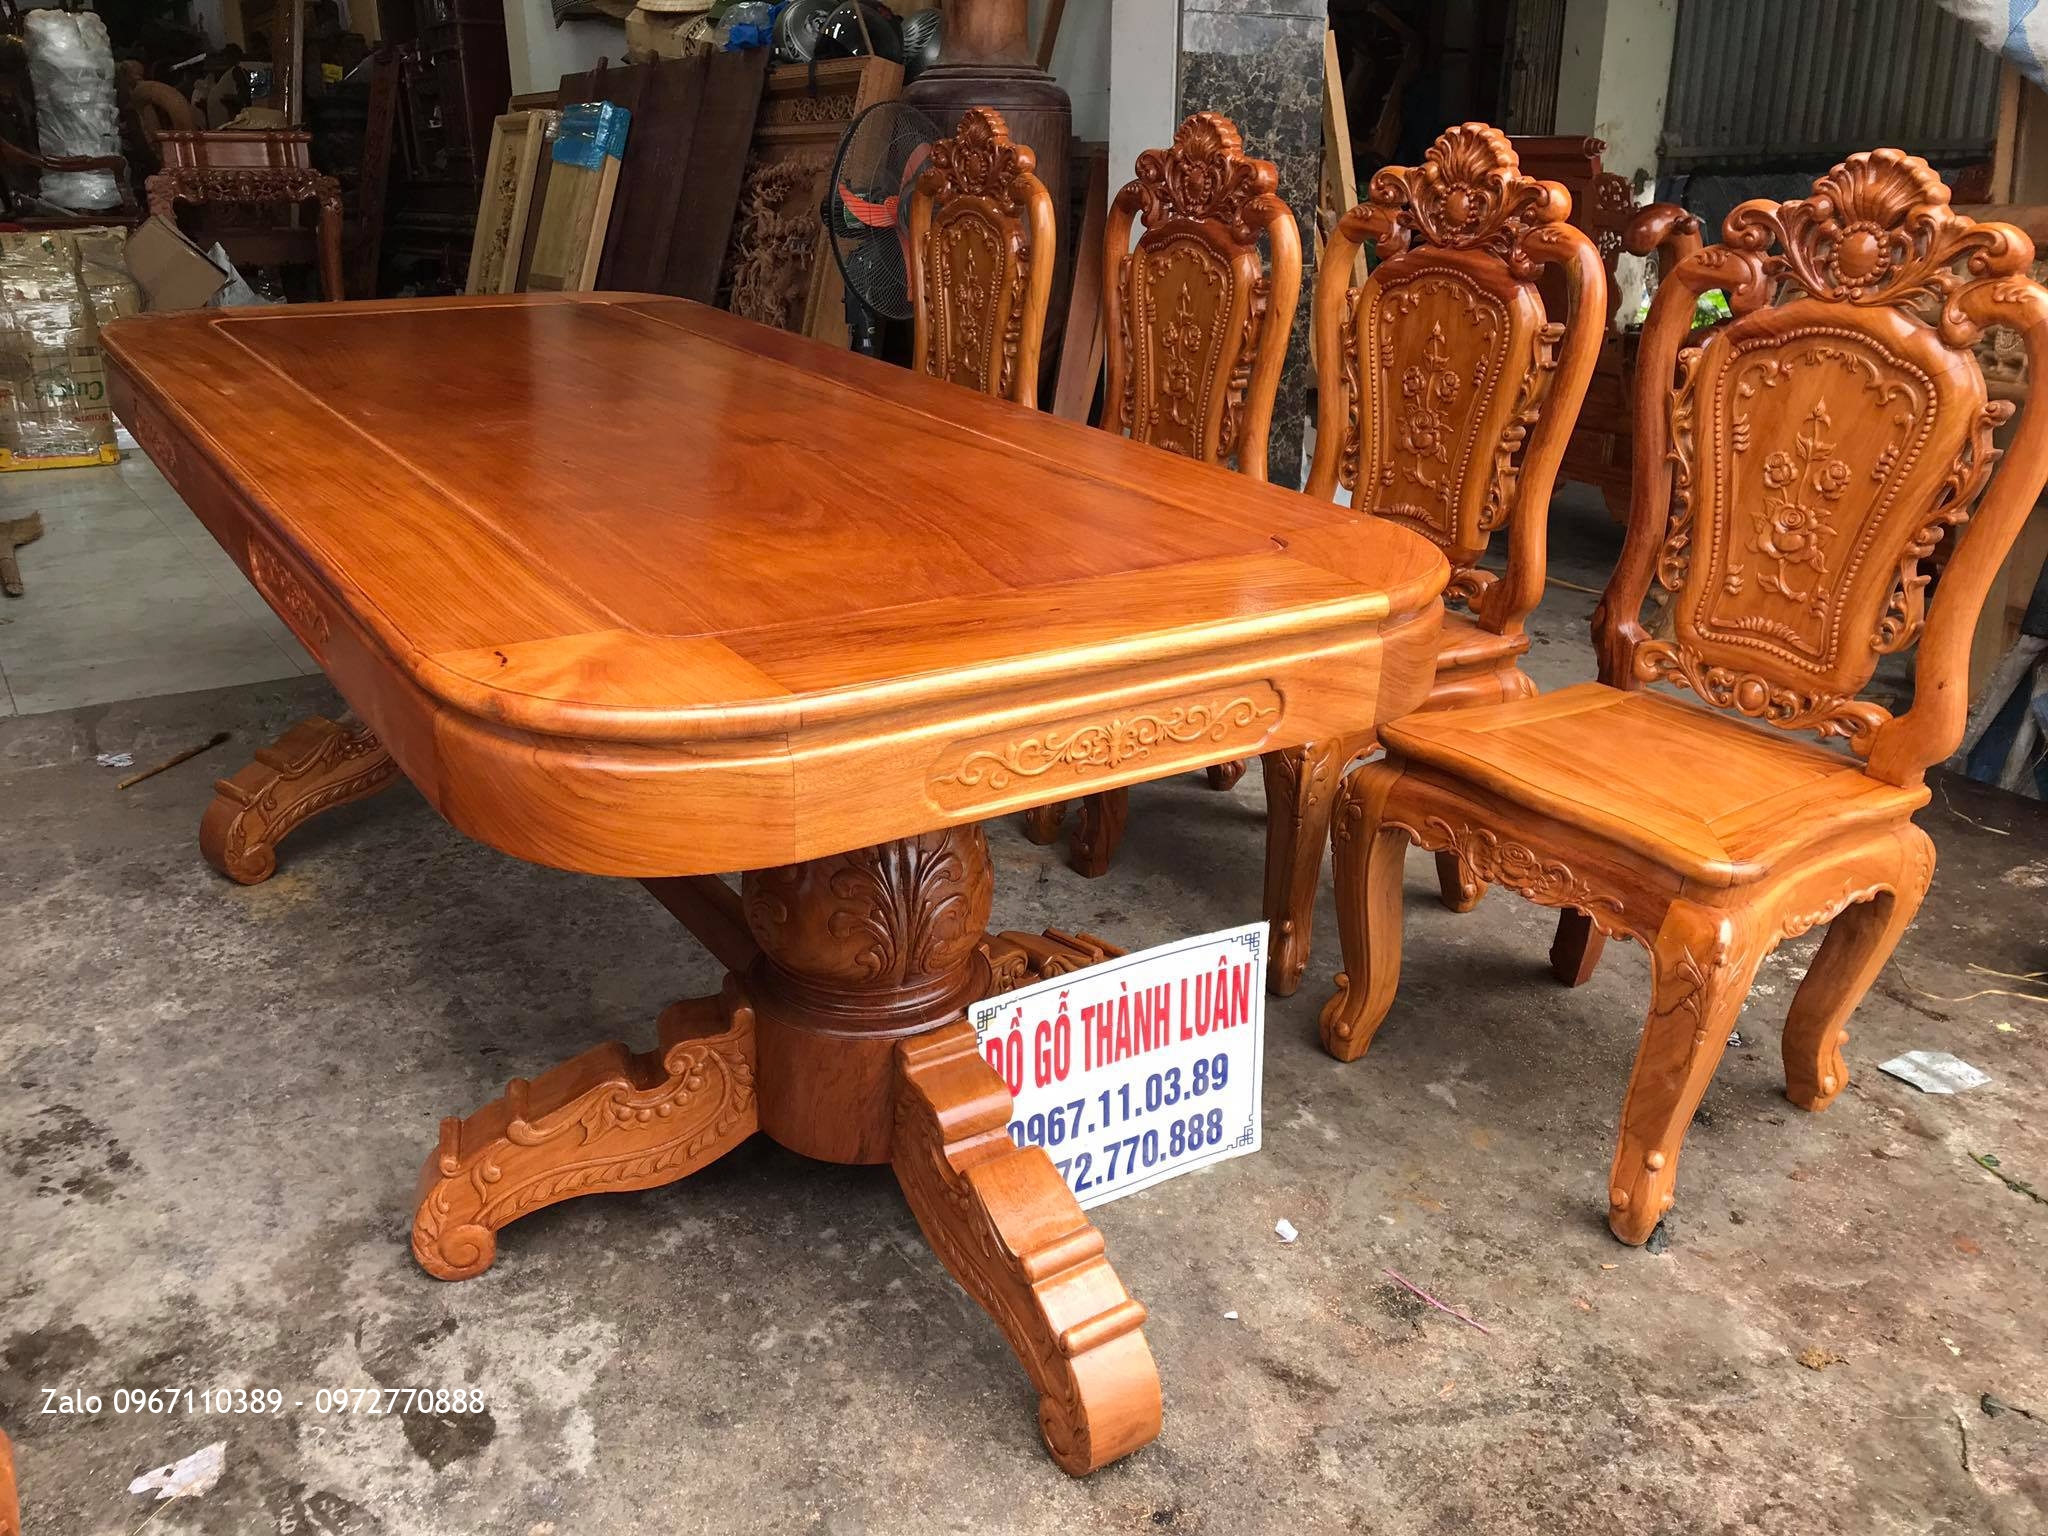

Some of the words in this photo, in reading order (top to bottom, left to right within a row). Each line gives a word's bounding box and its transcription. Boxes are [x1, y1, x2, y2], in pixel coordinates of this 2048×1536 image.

[1034, 990, 1071, 1089] GỖ
[1080, 981, 1171, 1072] THÀNH
[1179, 955, 1251, 1042] LUÂN
[1008, 1053, 1229, 1149] 0967.11.03.89
